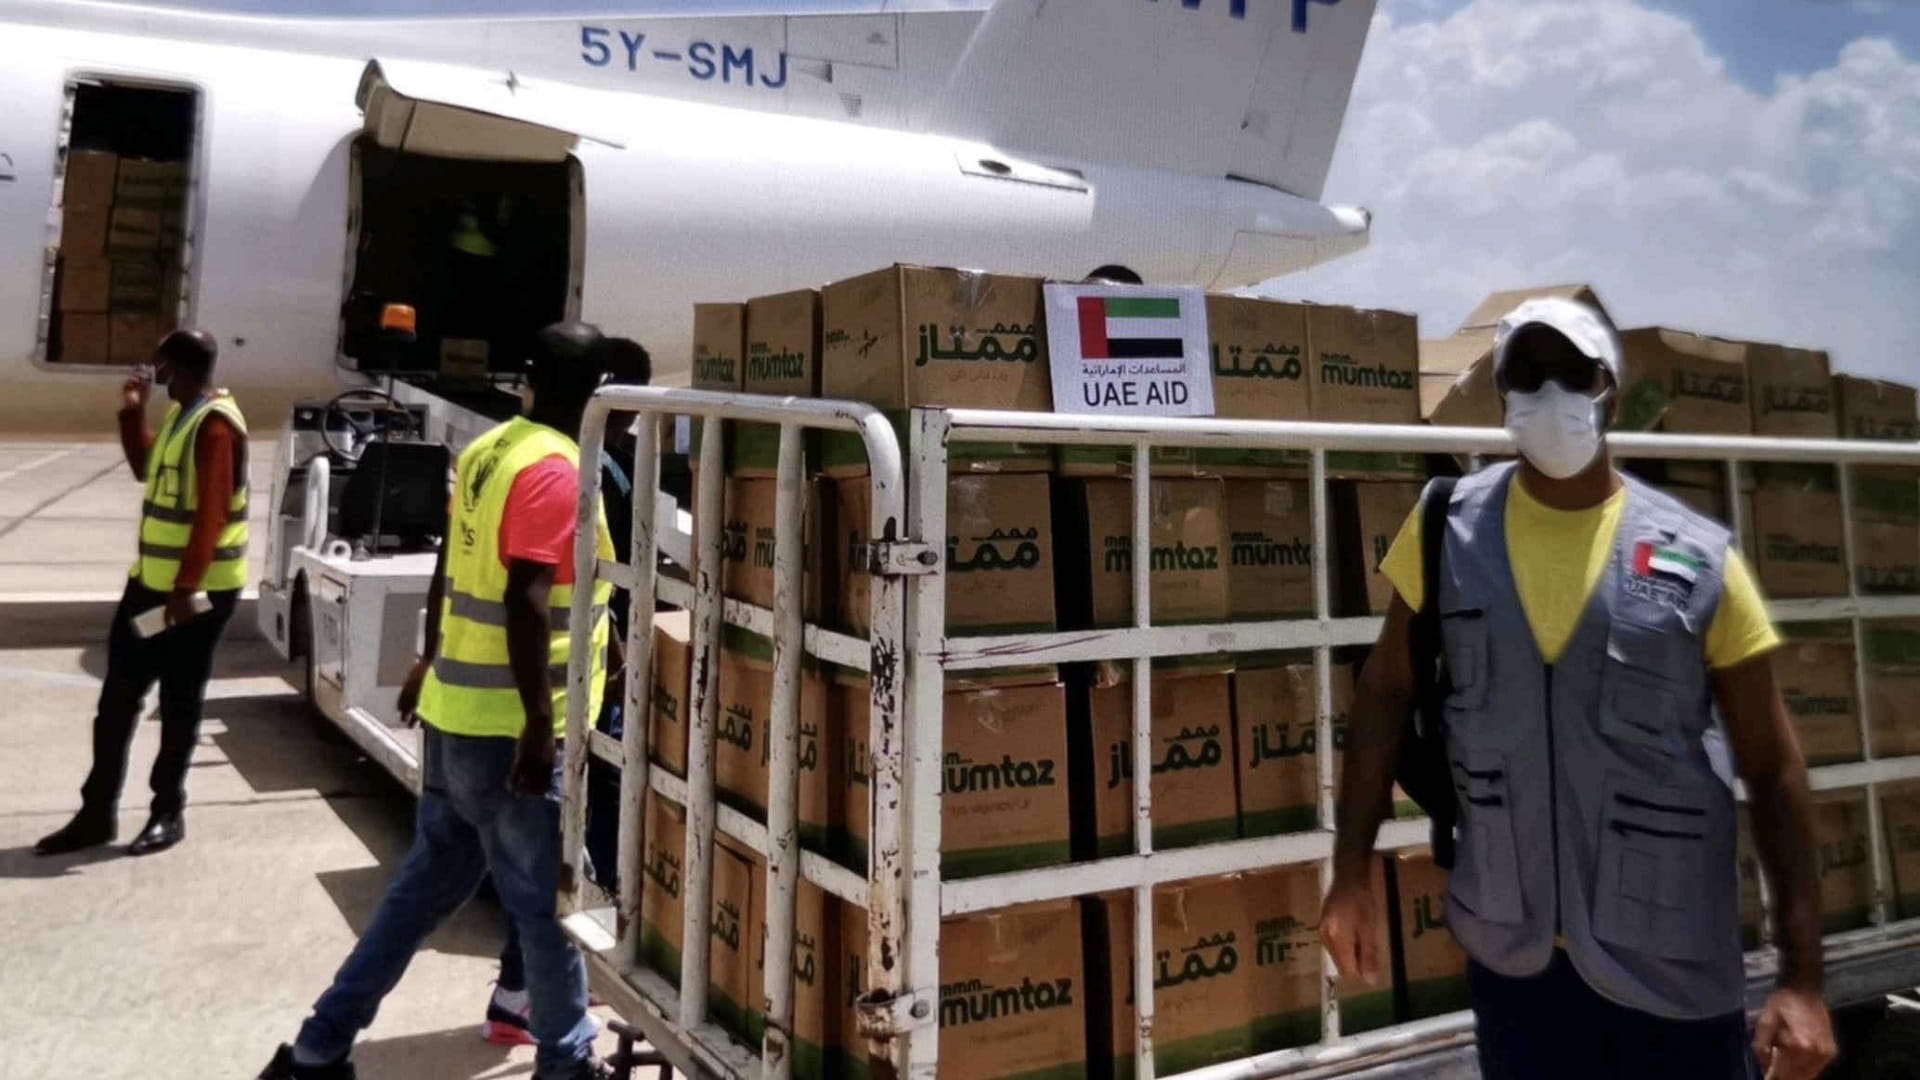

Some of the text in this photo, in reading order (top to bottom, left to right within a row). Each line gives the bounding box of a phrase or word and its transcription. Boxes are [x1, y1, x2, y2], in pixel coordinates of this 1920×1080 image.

[581, 25, 787, 89] 5Y-SMJ
[750, 346, 804, 381] mumtaz
[1212, 345, 1302, 380] ممتا
[1322, 363, 1413, 389] mumtaz
[1083, 381, 1188, 406] UAE AID
[1105, 541, 1218, 572] mmtaz
[942, 755, 1055, 793] umtaz
[940, 976, 1073, 1028] mumtaz
